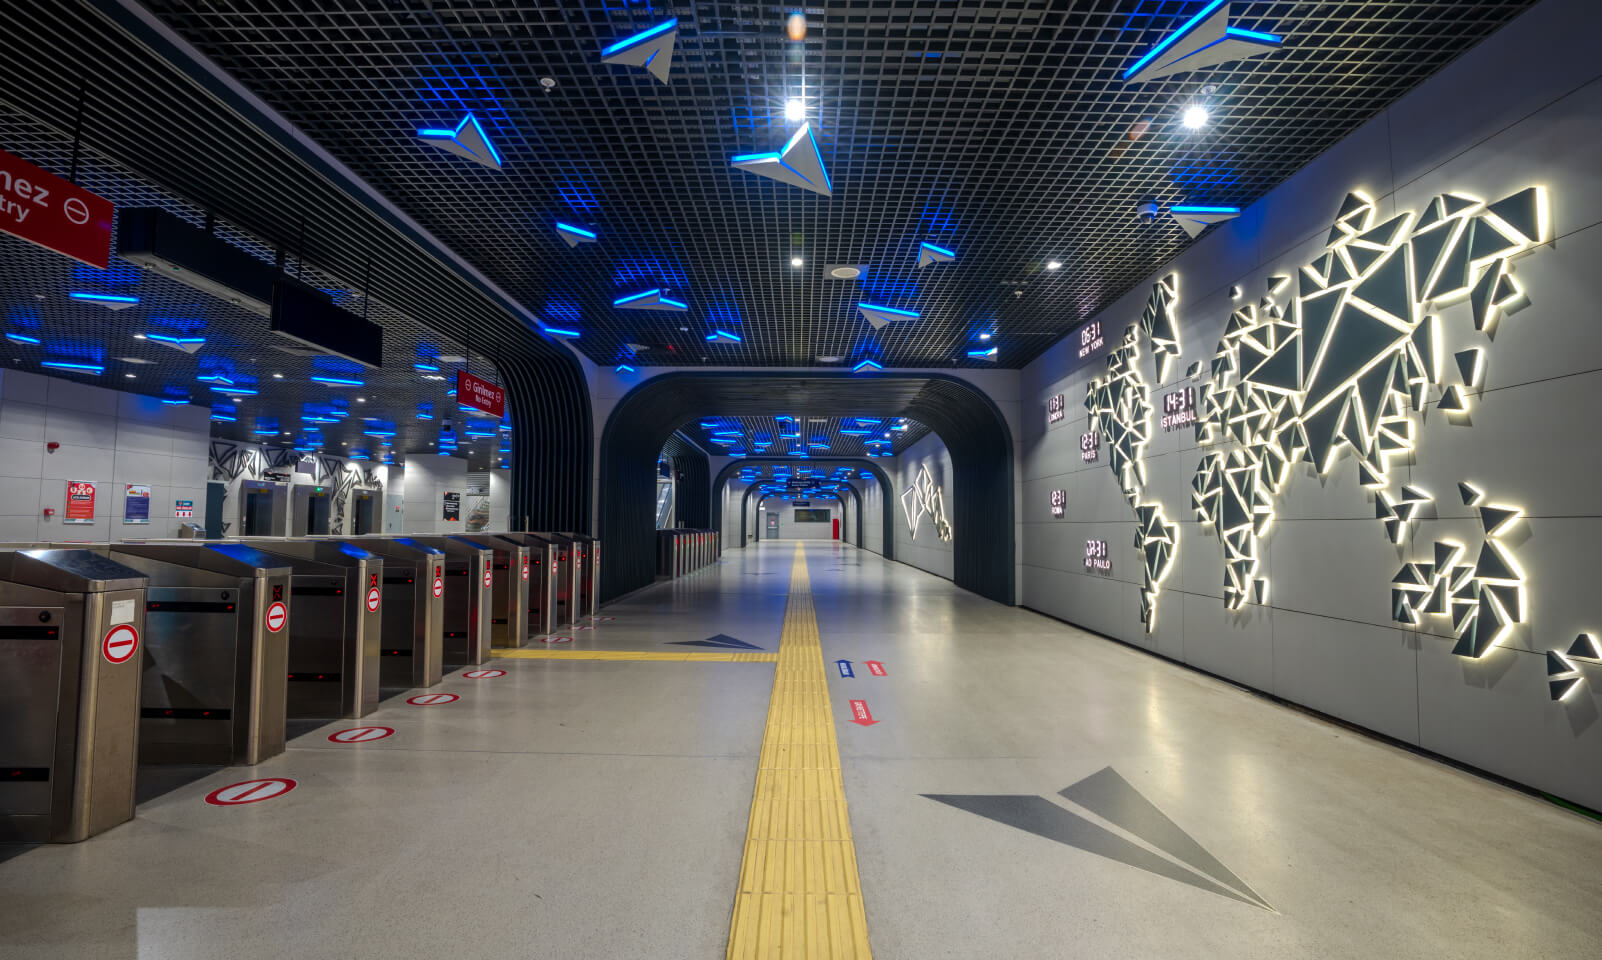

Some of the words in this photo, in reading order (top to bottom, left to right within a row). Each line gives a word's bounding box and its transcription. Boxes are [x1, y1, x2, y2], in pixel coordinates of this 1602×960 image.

[1079, 345, 1090, 358] NEW
[1090, 336, 1104, 351] YORK
[473, 382, 495, 400] Girilmez
[1166, 386, 1193, 412] 14:31
[1081, 449, 1096, 461] PARIS
[1093, 558, 1111, 569] PAULO
